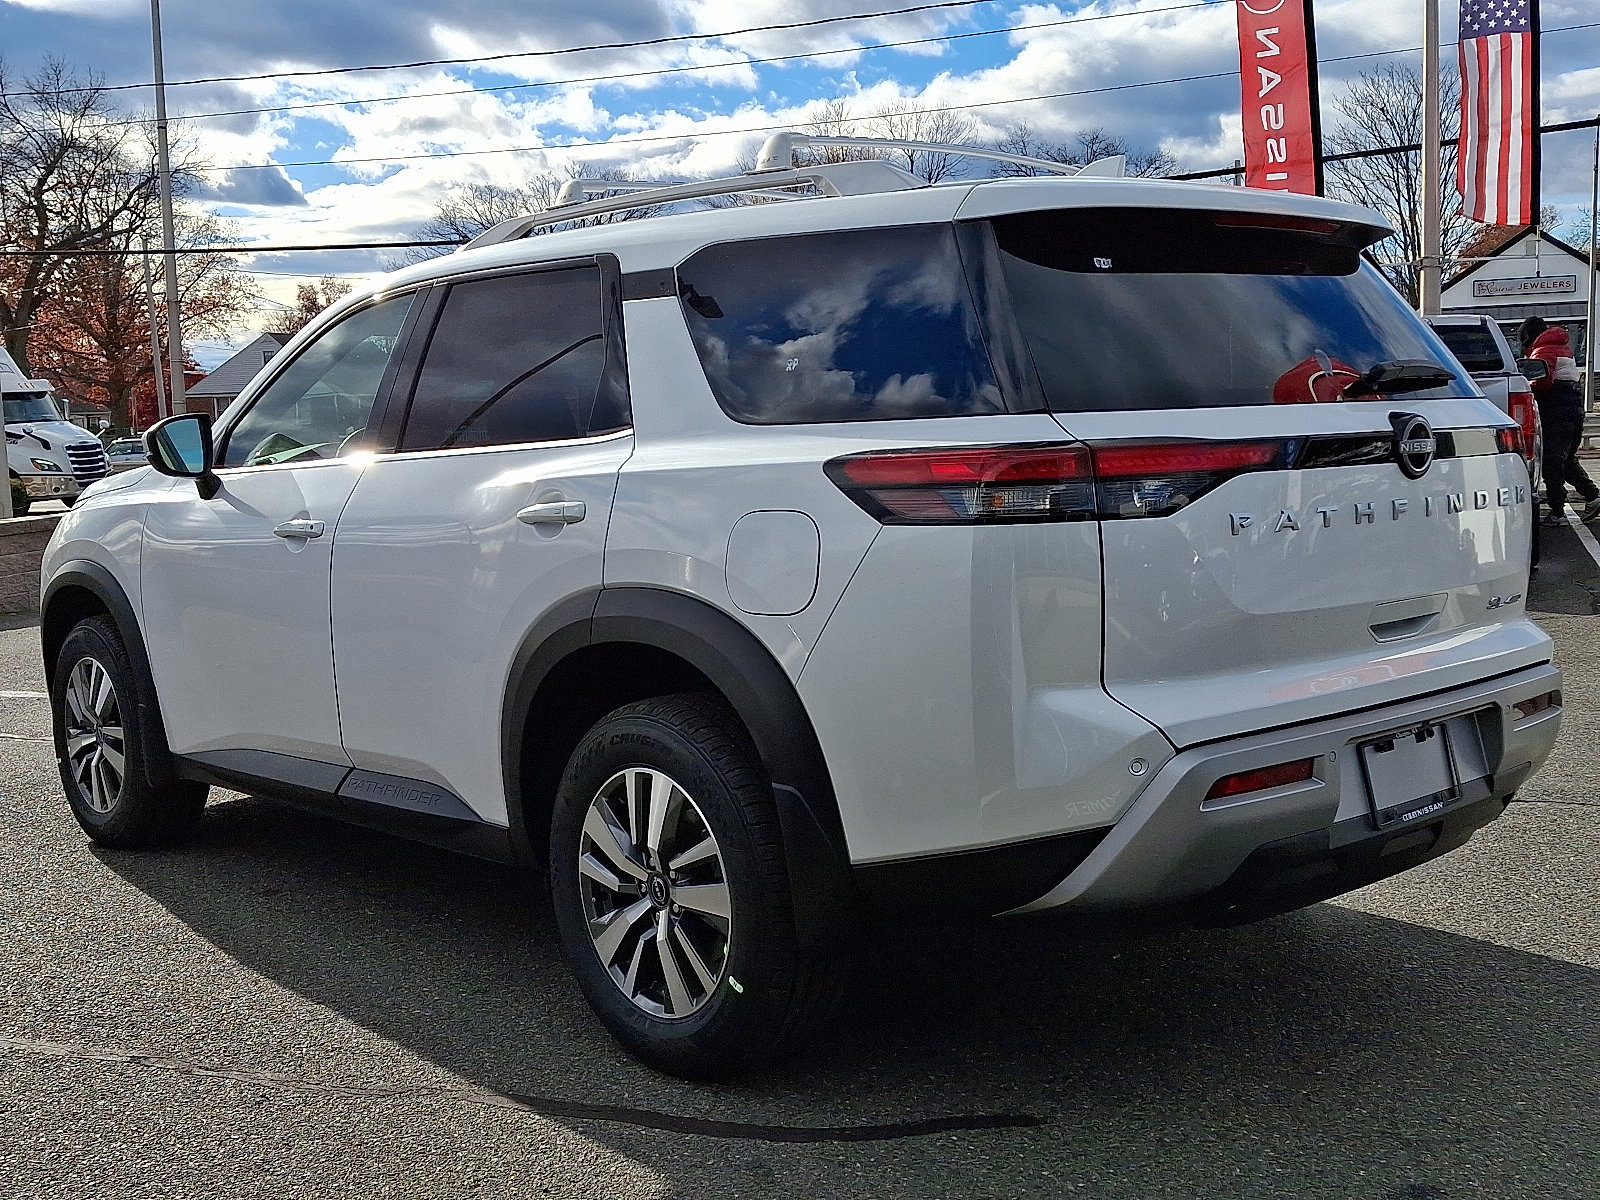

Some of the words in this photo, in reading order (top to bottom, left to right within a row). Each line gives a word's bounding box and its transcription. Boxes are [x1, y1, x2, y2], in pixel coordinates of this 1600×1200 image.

[1517, 280, 1572, 290] JEWELERS
[1400, 441, 1433, 452] NISSA
[1228, 484, 1527, 536] PATHFINDER
[346, 777, 442, 807] PATHFINDER
